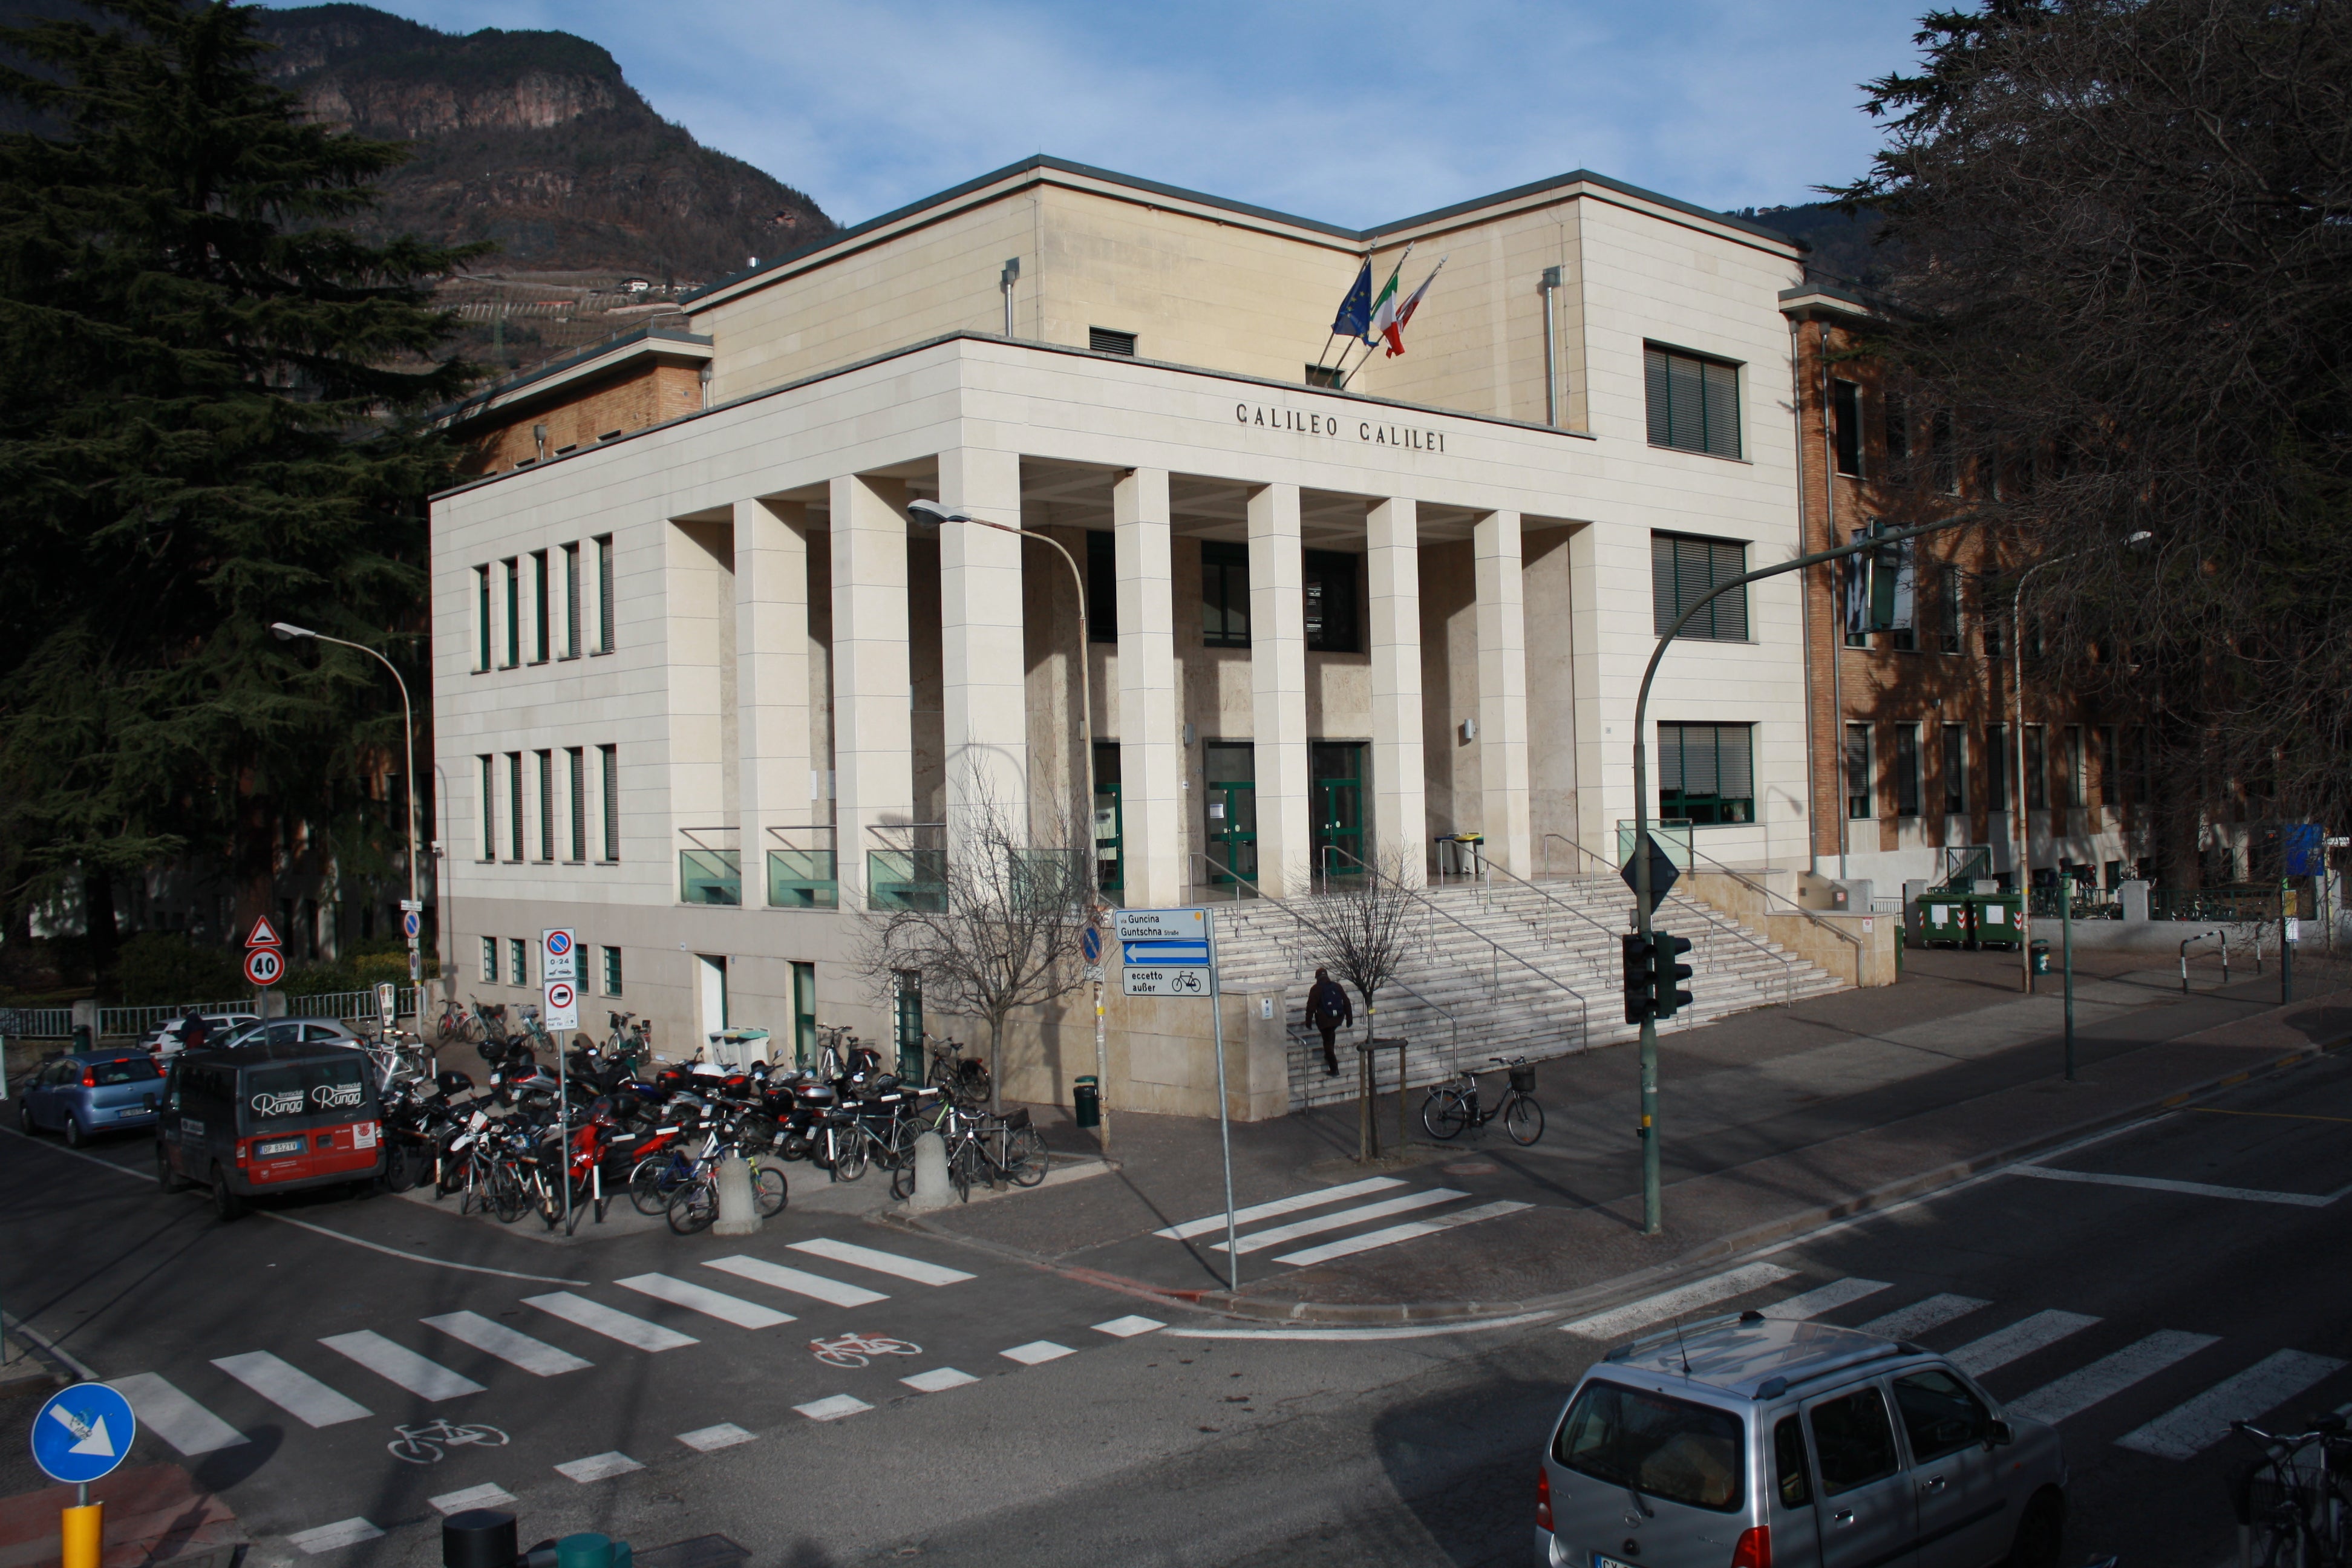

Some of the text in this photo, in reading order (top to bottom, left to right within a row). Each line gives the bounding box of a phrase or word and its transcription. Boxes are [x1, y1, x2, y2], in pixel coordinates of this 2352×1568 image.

[1236, 403, 1445, 452] GALILEO GALILEI
[1128, 914, 1160, 924] Guncina
[1121, 927, 1162, 936] Guntschna
[253, 958, 275, 975] 40
[1132, 972, 1163, 980] eccetto
[1132, 982, 1155, 992] außer
[312, 1085, 361, 1109] Rungg
[252, 1093, 303, 1117] Rungg
